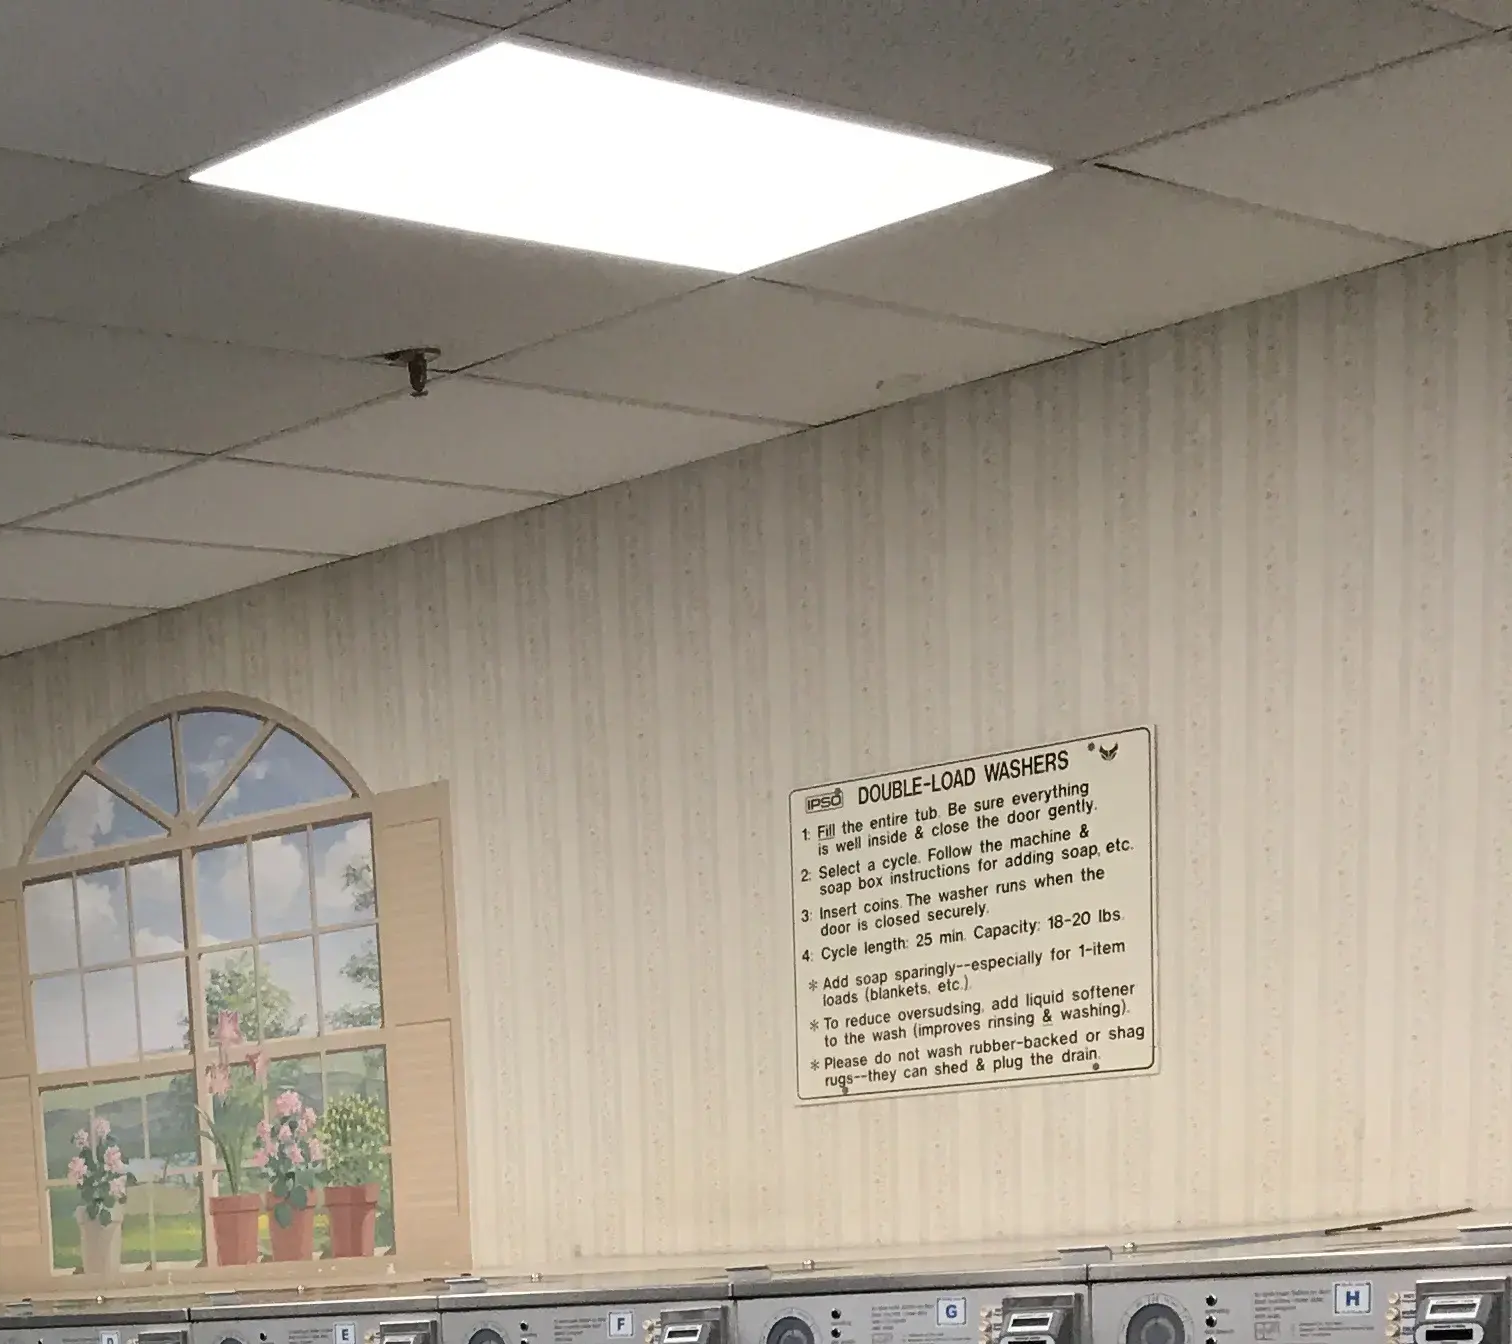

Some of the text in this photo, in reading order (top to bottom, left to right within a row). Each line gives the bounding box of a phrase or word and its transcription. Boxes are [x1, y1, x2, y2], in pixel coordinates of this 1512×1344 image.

[807, 750, 1069, 810] IPSO DOUBLE-LOAD WASHERS
[818, 824, 835, 838] Fill
[842, 820, 863, 835] the
[870, 812, 908, 830] entire
[948, 802, 967, 817] Be
[974, 797, 1004, 812] sure
[1012, 782, 1089, 805] everything
[818, 799, 1097, 856] is well inside & close the door gently.
[818, 860, 860, 879] Select
[867, 860, 876, 872] a
[882, 852, 921, 871] cycle.
[928, 844, 972, 862] Follow
[980, 840, 1003, 853] the
[1010, 829, 1071, 849] machine
[1079, 823, 1090, 838] &
[819, 881, 852, 895] soap
[858, 876, 883, 890] box
[890, 862, 971, 885] instructions
[978, 858, 997, 872] for
[1005, 850, 1054, 868] adding
[1105, 837, 1135, 853] etc.
[819, 902, 857, 920] Insert
[906, 893, 931, 907] The
[938, 885, 988, 902] washer
[996, 879, 1027, 894] runs
[1034, 873, 1073, 888] when
[1081, 867, 1105, 882] the
[821, 902, 989, 937] door is closed securely.
[821, 944, 858, 962] Cycle
[916, 932, 933, 948] 25
[973, 919, 1041, 940] Capacity:
[1047, 911, 1091, 929] 18-20
[823, 975, 849, 990] Add
[855, 972, 888, 987] soap
[1050, 947, 1071, 961] for
[1079, 941, 1126, 957] 1-item
[823, 992, 858, 1006] loads
[823, 1017, 839, 1030] To
[845, 1012, 891, 1028] reduce
[991, 995, 1019, 1011] add
[1026, 990, 1064, 1009] liquid
[1072, 984, 1135, 1002] softener
[824, 1026, 1145, 1070] Please do not wash rubber-backed or shag
[825, 1035, 838, 1047] to
[844, 1032, 865, 1045] the
[872, 1026, 907, 1042] wash
[913, 1019, 980, 1039] (improves
[988, 1013, 1035, 1029] rinsing
[1042, 1009, 1053, 1023] &
[903, 1066, 928, 1079] can
[935, 1060, 968, 1076] shed
[975, 1058, 985, 1071] &
[993, 1055, 1023, 1073] plug
[1030, 1052, 1053, 1066] the
[946, 1305, 957, 1318] G
[1346, 1290, 1360, 1306] H
[341, 1329, 349, 1340] E
[617, 1317, 625, 1331] F
